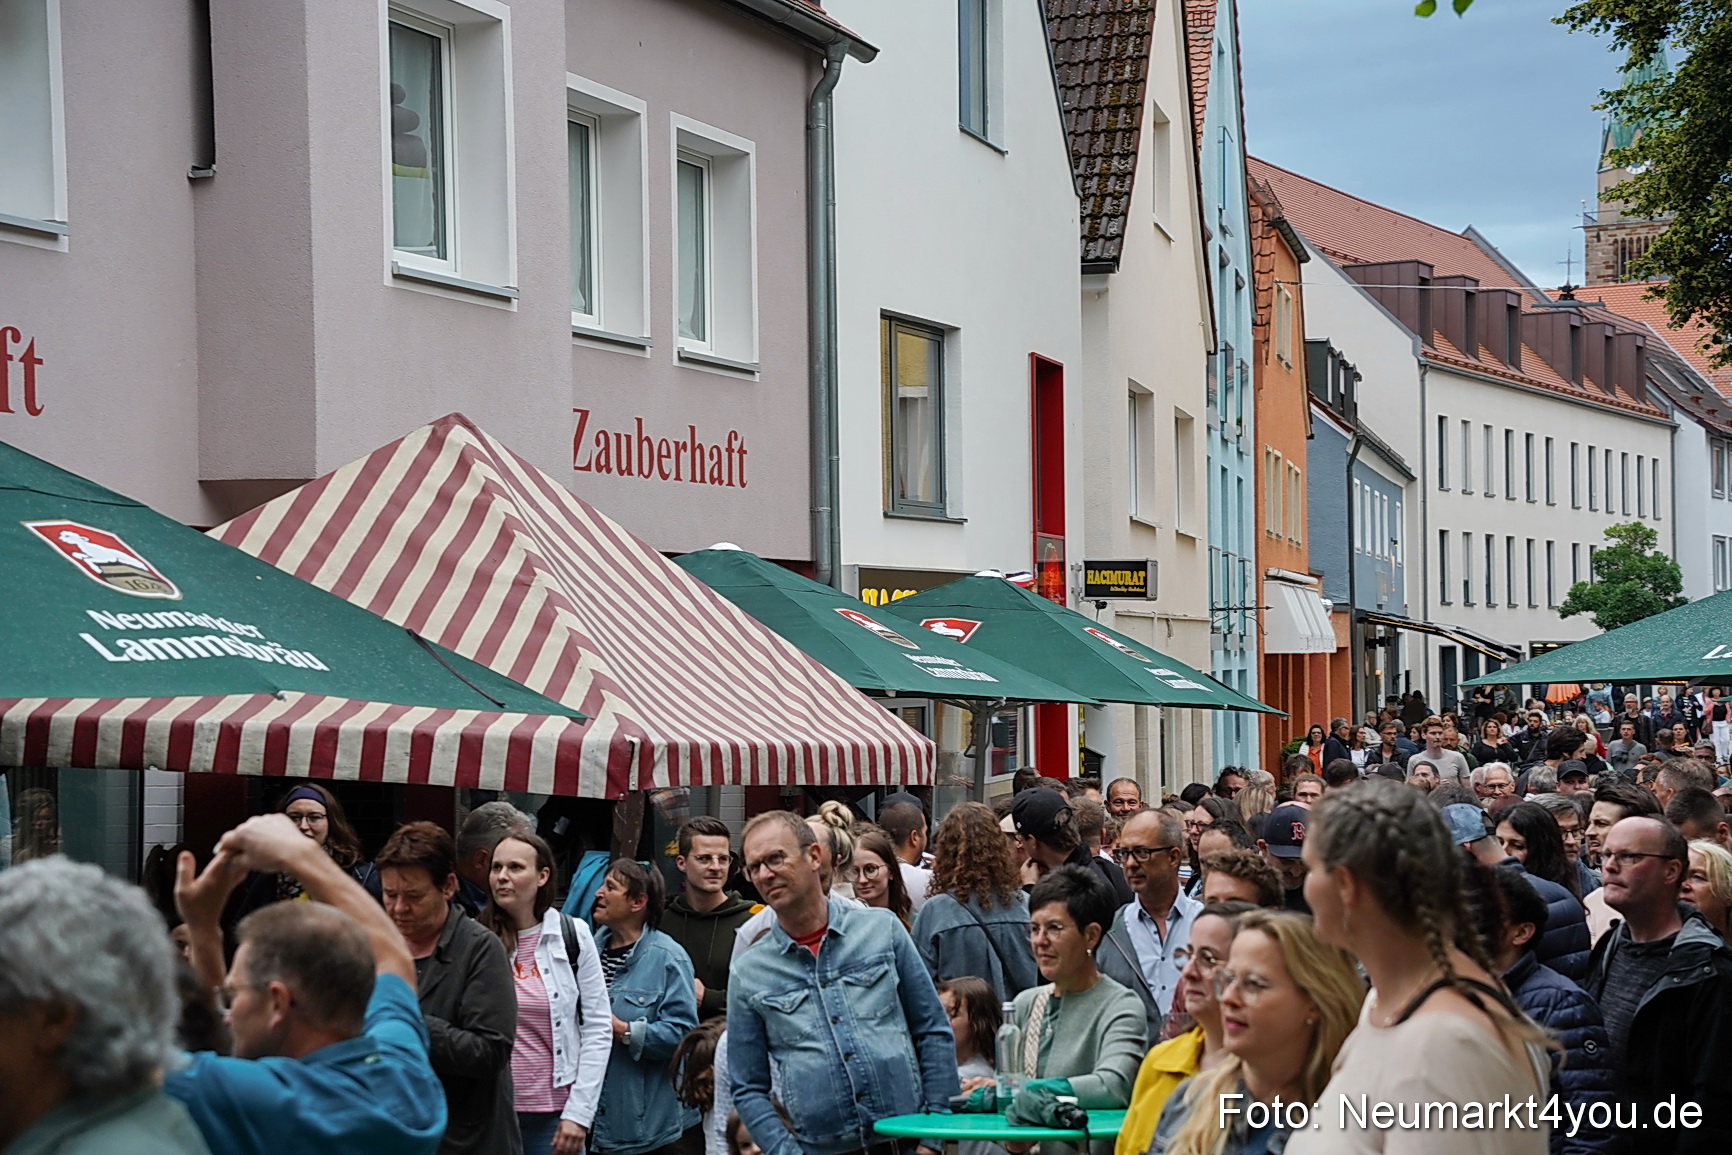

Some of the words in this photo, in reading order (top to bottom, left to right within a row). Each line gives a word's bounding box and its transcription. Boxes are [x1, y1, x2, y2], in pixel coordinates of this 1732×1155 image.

[573, 408, 748, 488] Zauberhaft
[1086, 569, 1146, 585] HACIMURAT
[86, 609, 266, 639] Neumarkter
[78, 632, 331, 671] Lammsbräu
[1290, 821, 1306, 840] B
